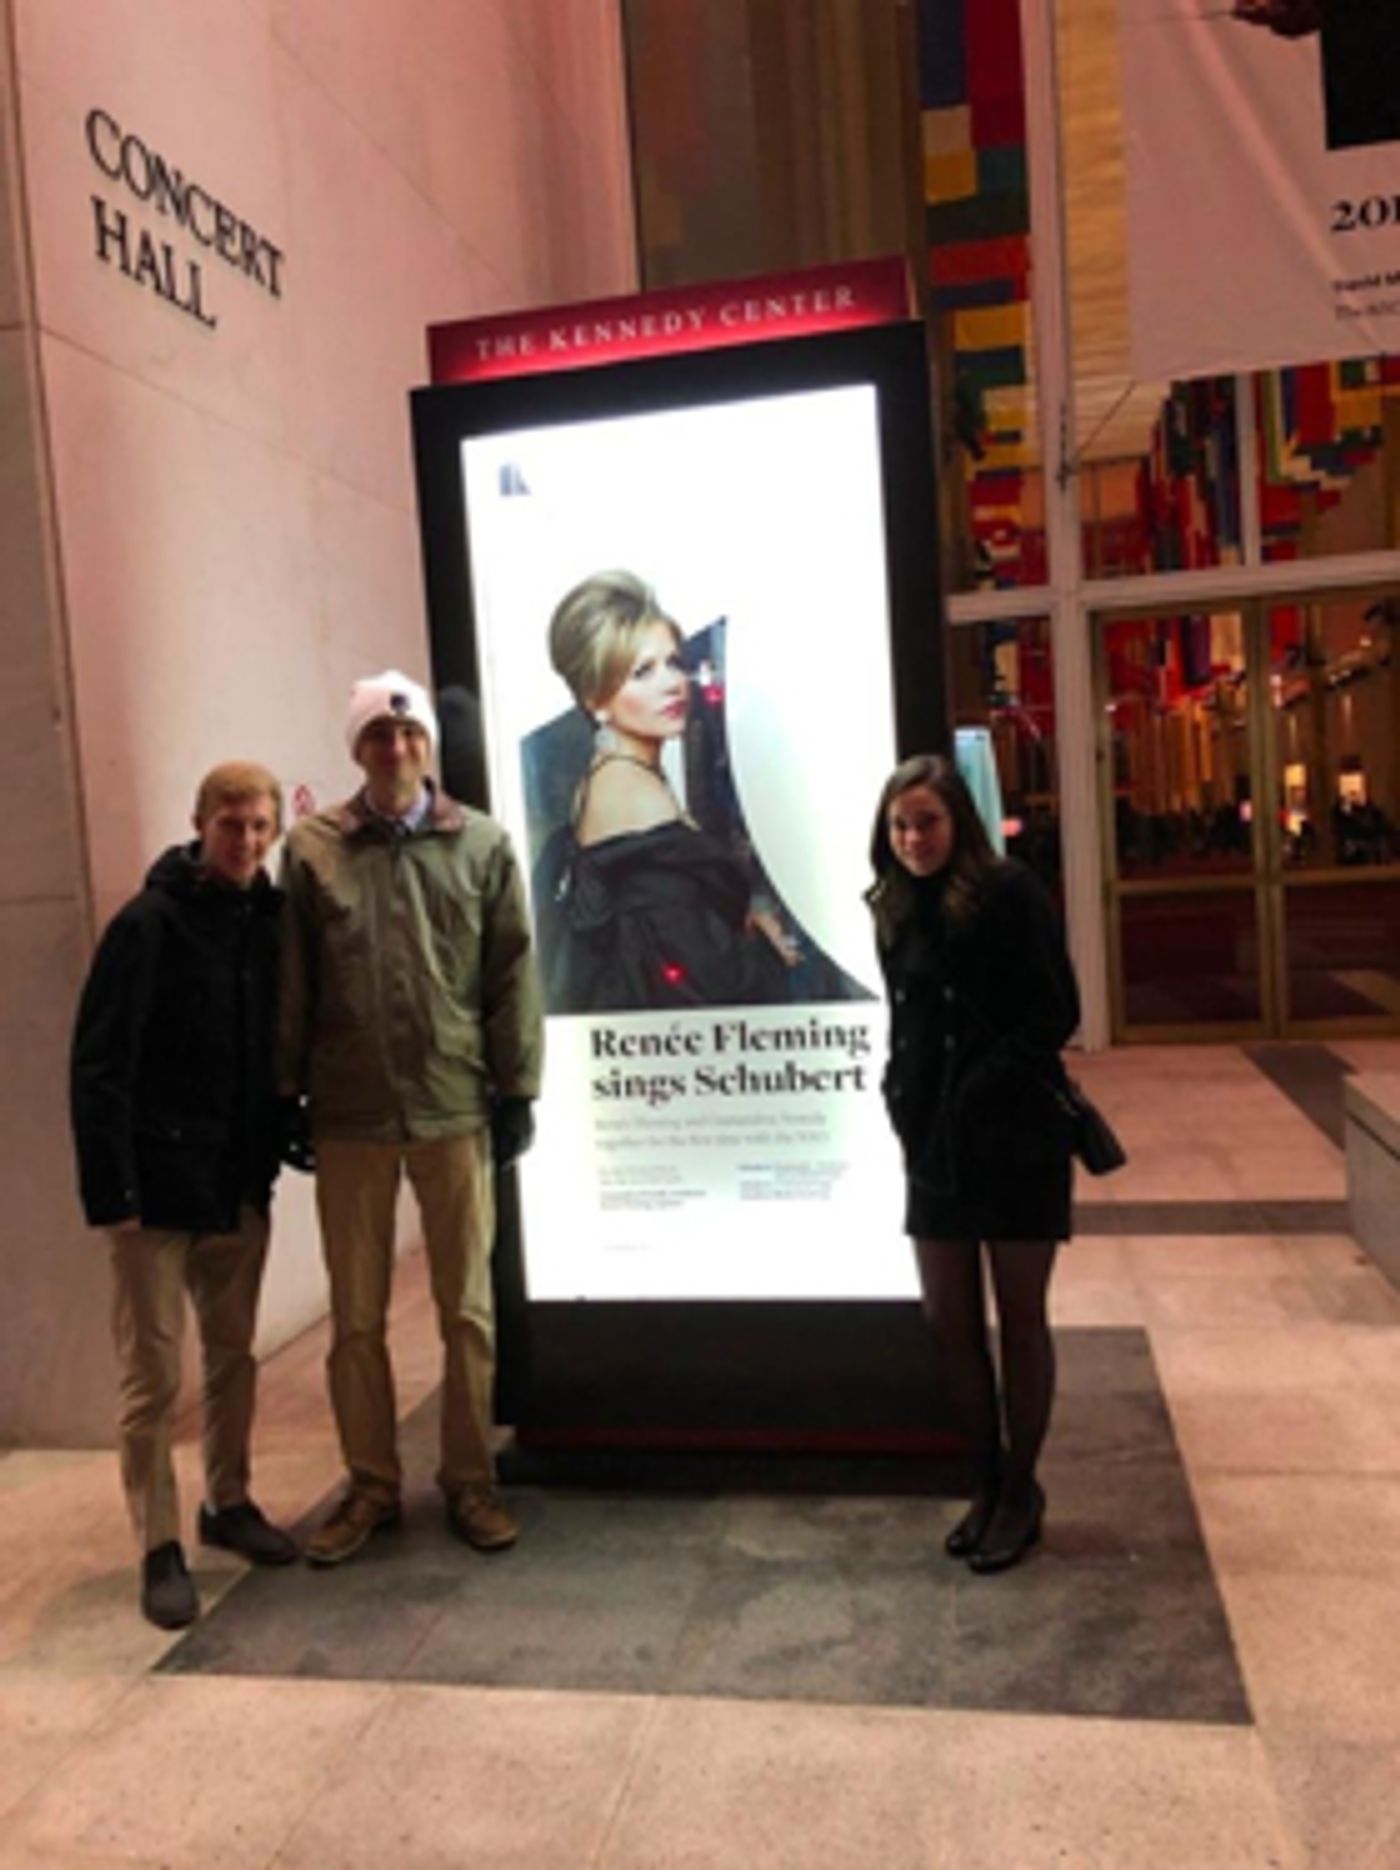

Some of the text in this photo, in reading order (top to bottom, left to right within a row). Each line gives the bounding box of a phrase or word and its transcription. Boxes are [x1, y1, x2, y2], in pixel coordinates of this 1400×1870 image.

[86, 109, 284, 299] CONCERT
[90, 195, 217, 329] HALL
[476, 287, 856, 361] THE KENNEDY CENTER
[590, 1017, 872, 1059] Renée Fleming
[591, 1060, 867, 1108] sings Schubert
